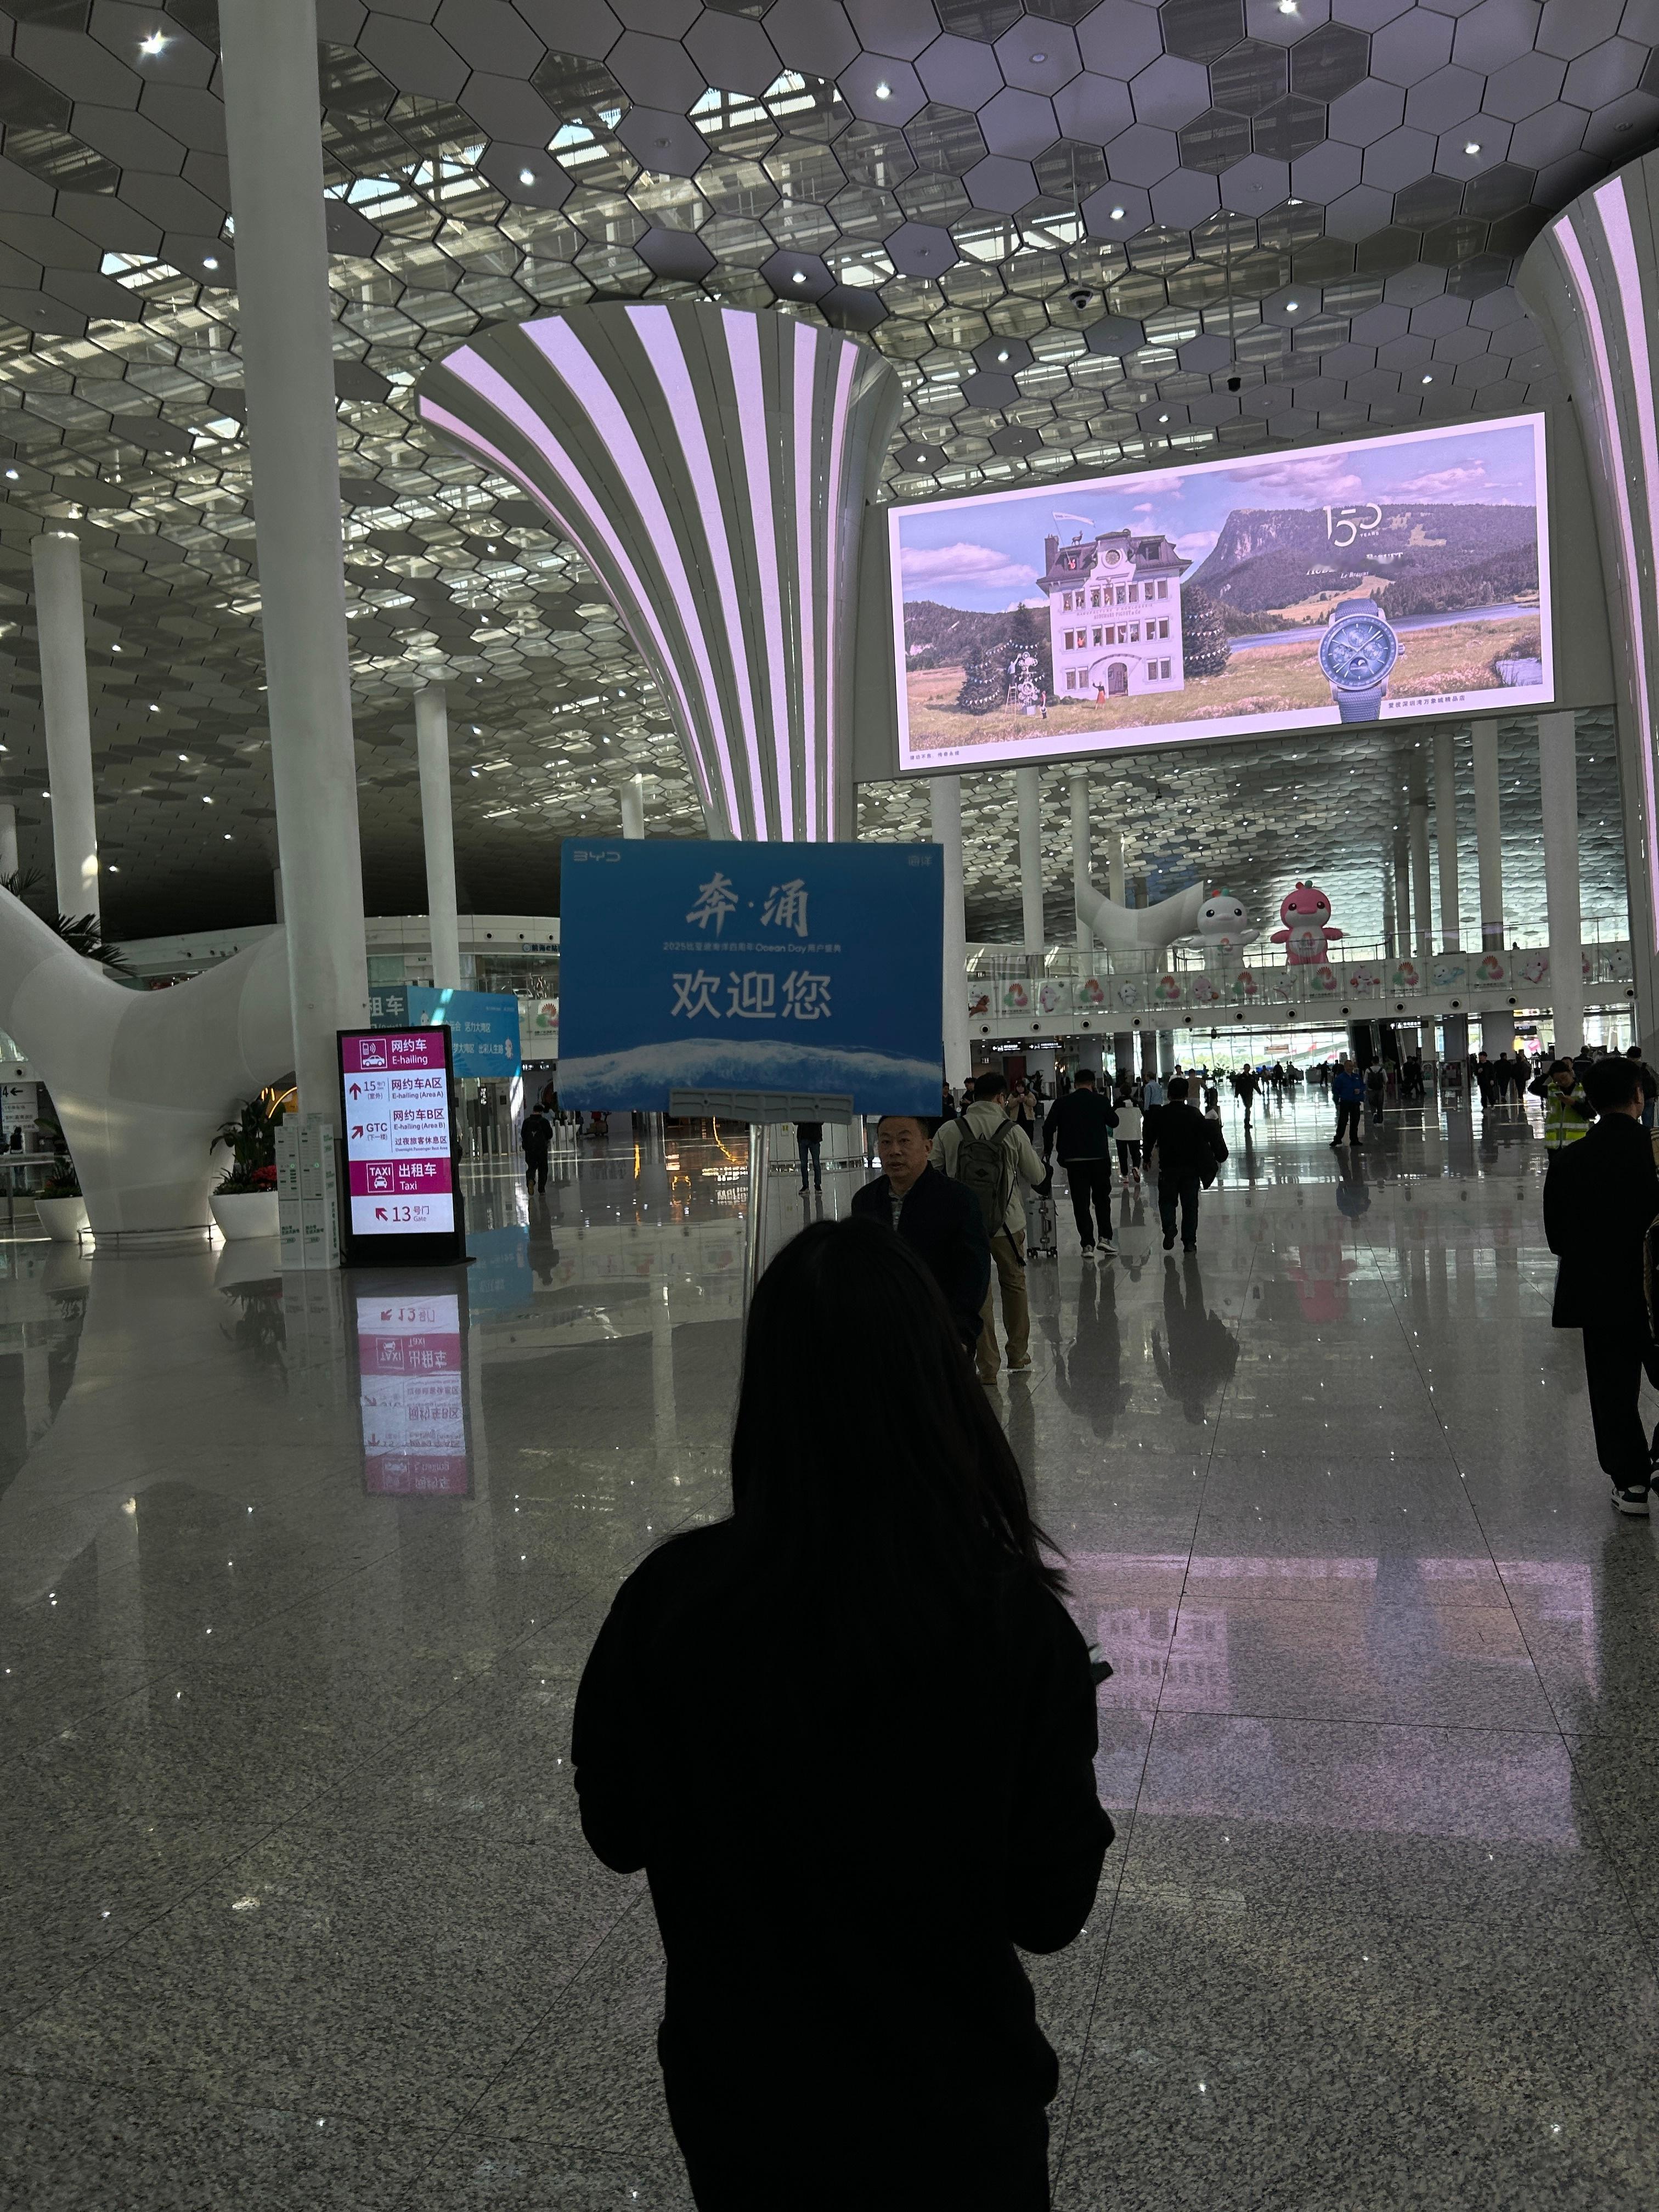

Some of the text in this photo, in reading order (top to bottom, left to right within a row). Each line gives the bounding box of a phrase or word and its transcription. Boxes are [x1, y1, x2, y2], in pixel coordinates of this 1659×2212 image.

[1323, 503, 1383, 547] 150
[573, 850, 621, 862] BYD
[670, 969, 832, 1020] 欢迎您
[391, 1038, 427, 1053] 网约车
[392, 1054, 428, 1066] E-hailing
[364, 1081, 376, 1091] 15
[391, 1077, 443, 1091] 网约车A区
[392, 1092, 419, 1101] E-hailing
[393, 1108, 445, 1121] 网约车B区
[366, 1122, 388, 1132] GTC
[421, 1122, 438, 1130] (Area
[438, 1121, 445, 1130] B)
[394, 1136, 447, 1146] 过夜旅客休息区
[370, 1166, 391, 1176] TAXI
[398, 1163, 437, 1178] 出租车
[399, 1181, 417, 1191] Taxi
[392, 1205, 430, 1222] 13 号门
[413, 1214, 427, 1222] Gate
